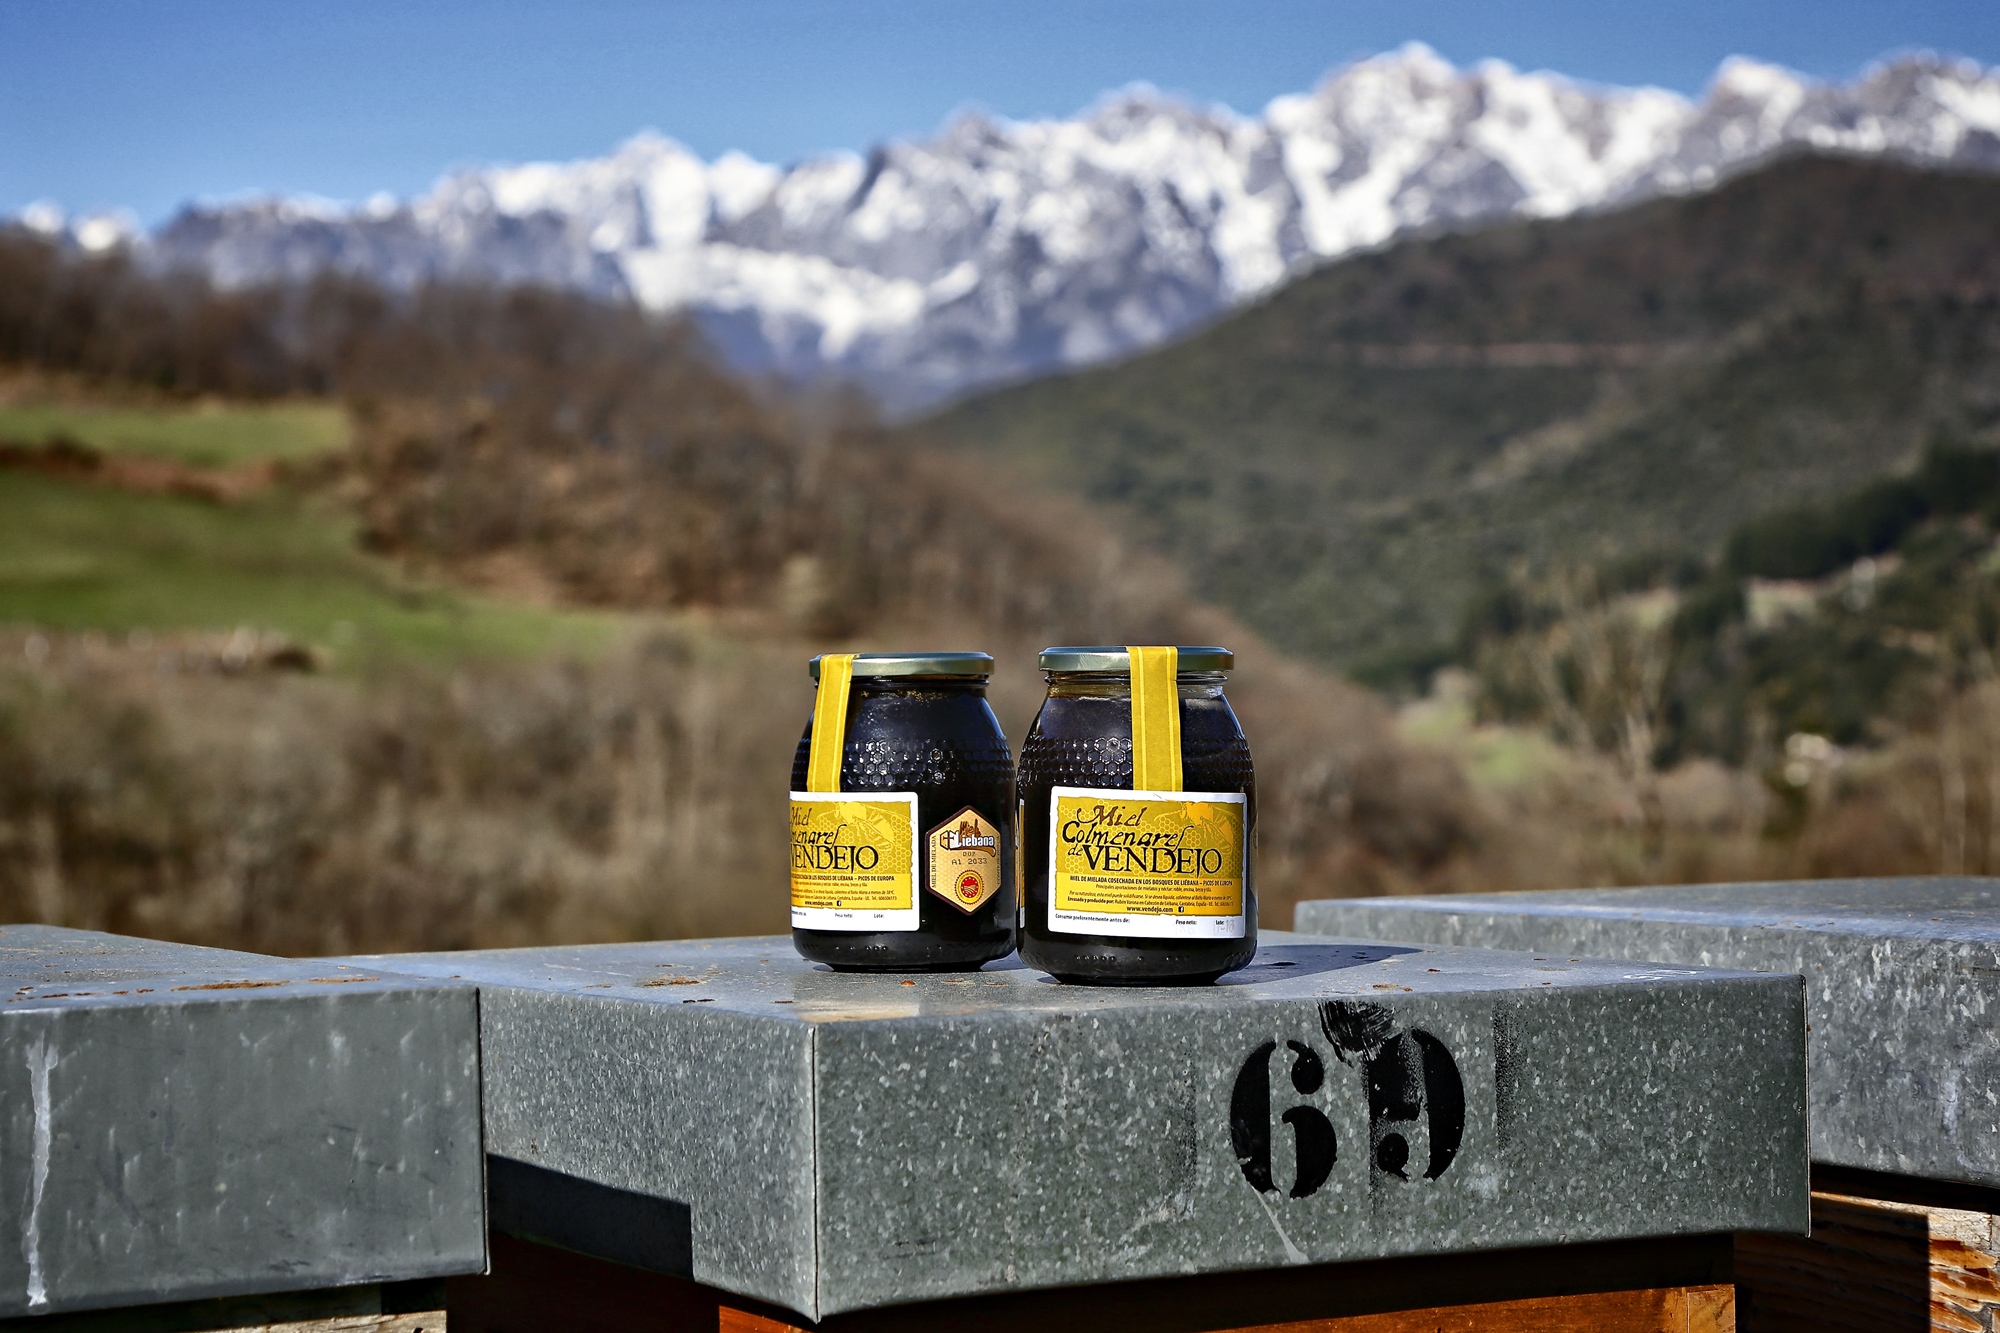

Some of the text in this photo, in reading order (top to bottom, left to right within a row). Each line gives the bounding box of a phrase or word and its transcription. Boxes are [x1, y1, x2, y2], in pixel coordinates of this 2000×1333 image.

[1078, 804, 1148, 826] Miel
[1068, 844, 1222, 878] de VENDEJO
[1230, 1028, 1466, 1198] 69
